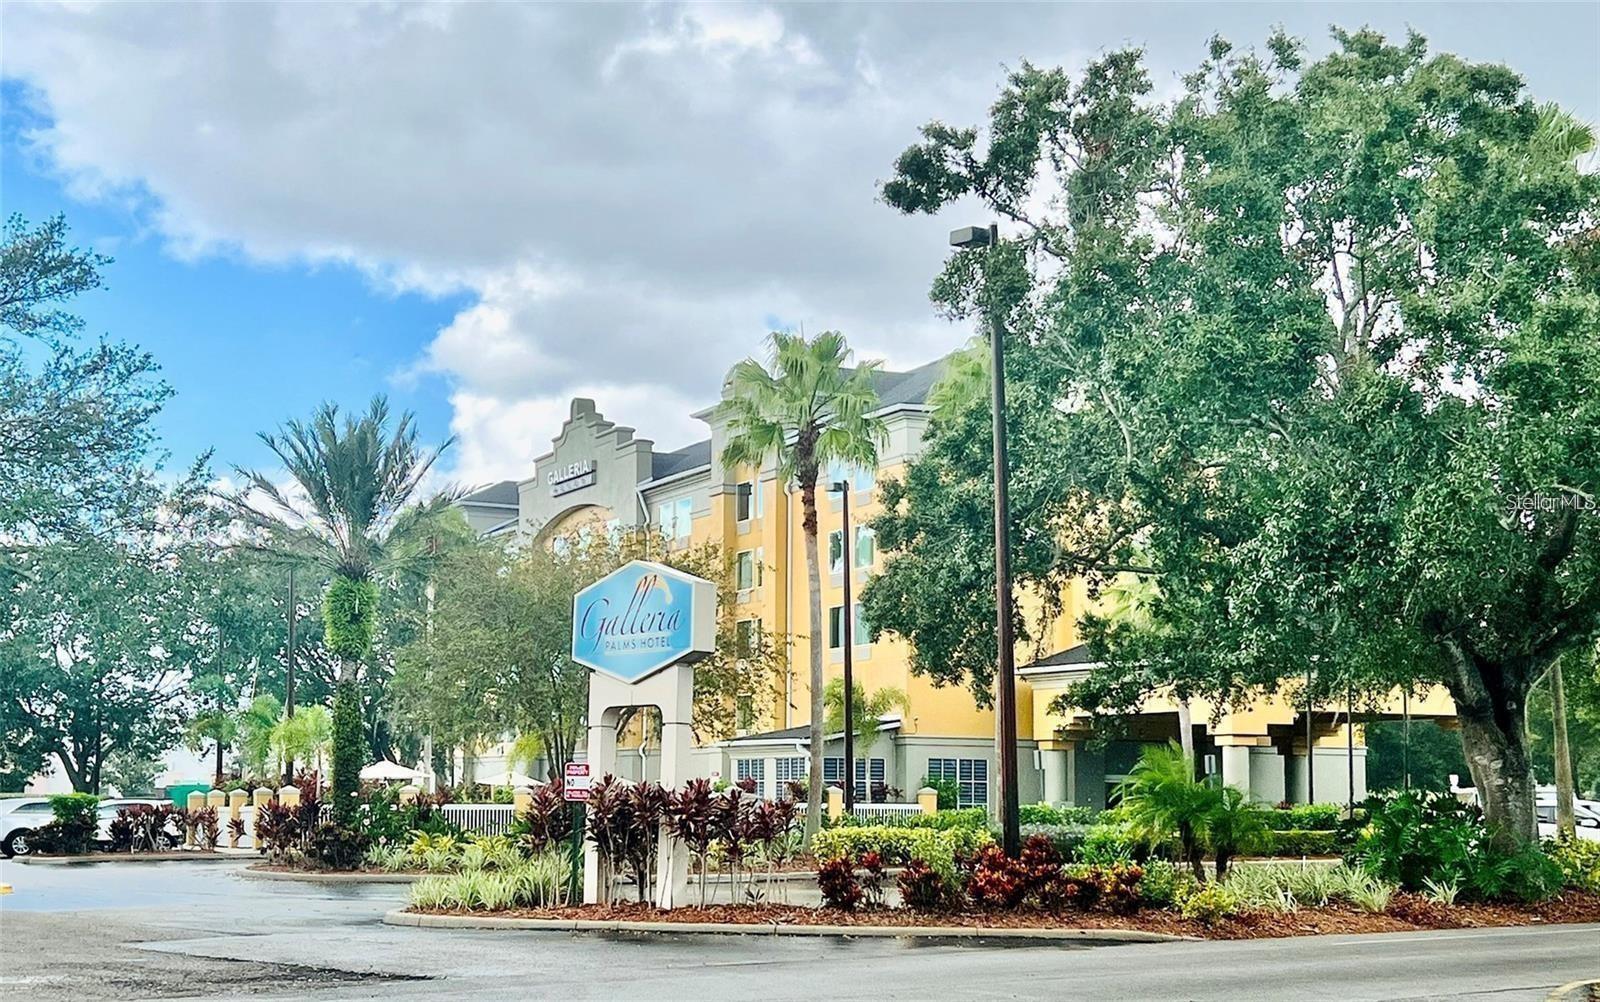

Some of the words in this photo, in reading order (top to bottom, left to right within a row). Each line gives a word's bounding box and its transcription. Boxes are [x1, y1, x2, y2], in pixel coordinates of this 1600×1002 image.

[547, 459, 590, 485] GALLERIA
[580, 574, 682, 653] Galleria
[605, 639, 637, 651] PALMS
[640, 636, 671, 649] HOTEL
